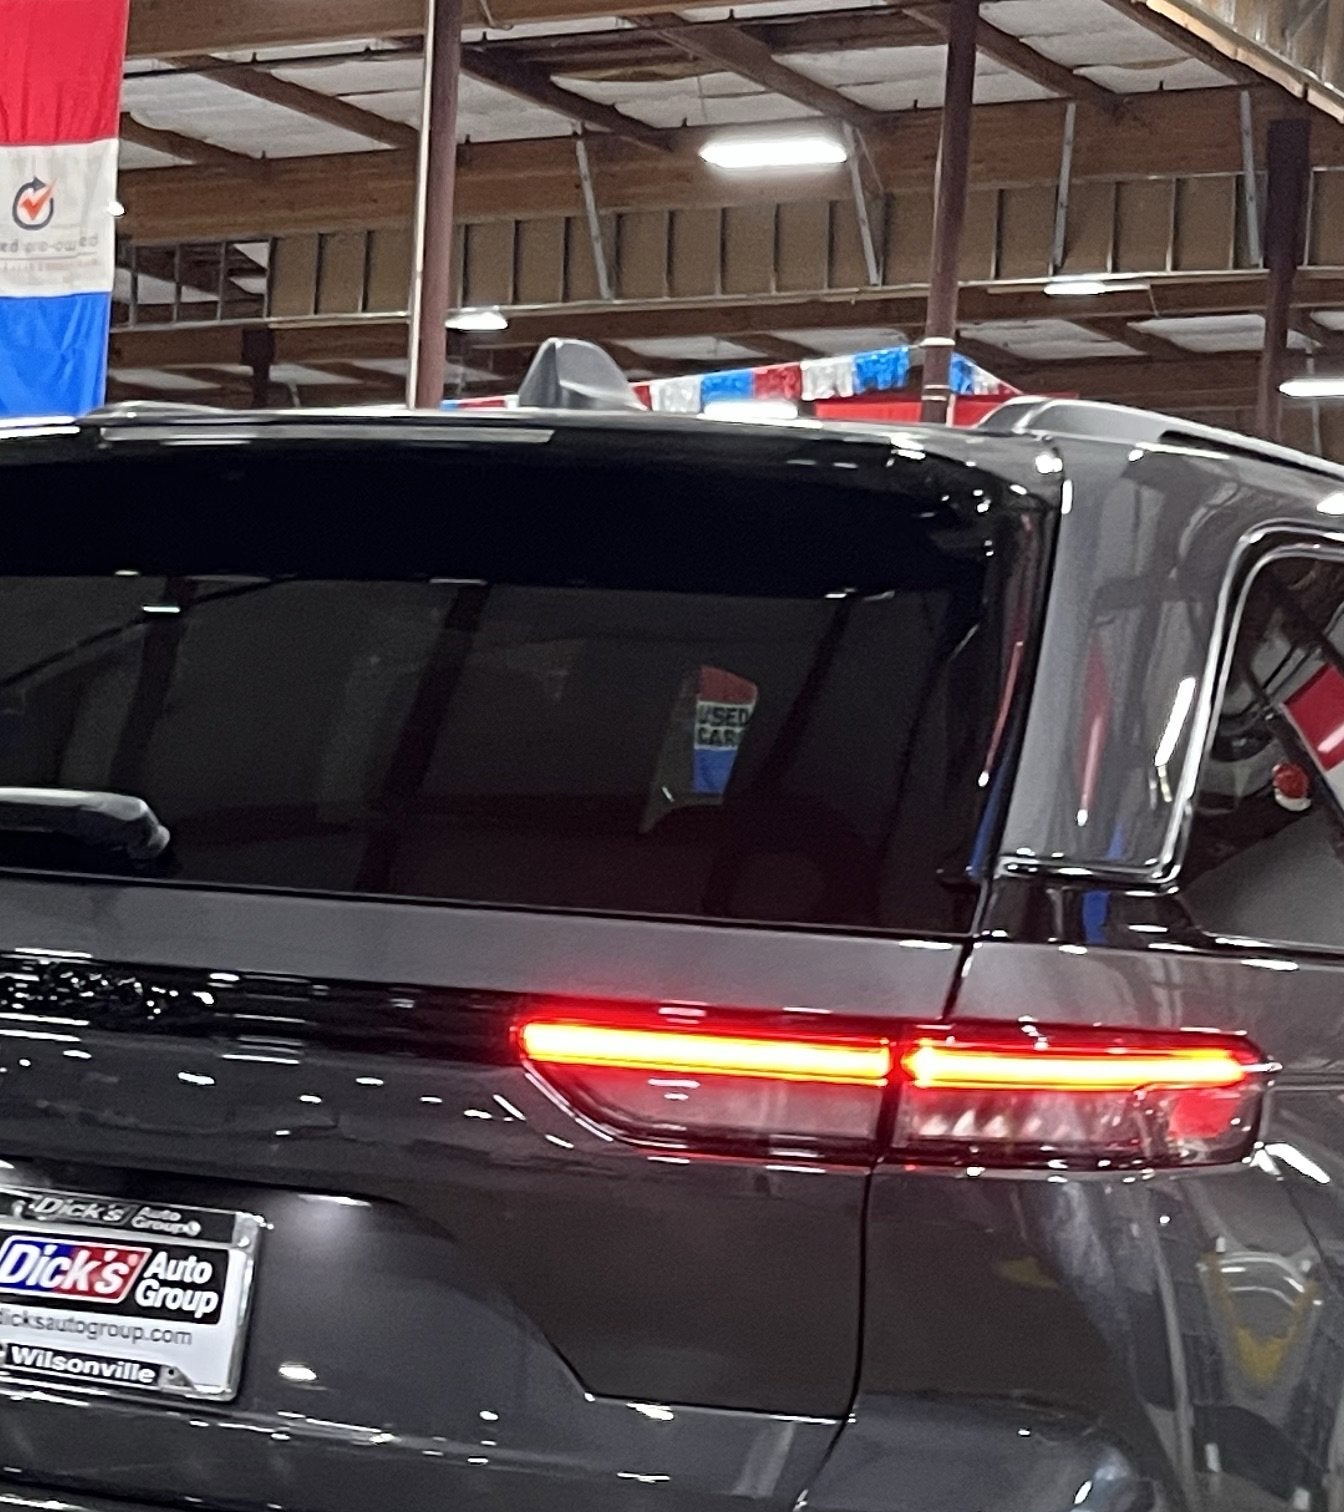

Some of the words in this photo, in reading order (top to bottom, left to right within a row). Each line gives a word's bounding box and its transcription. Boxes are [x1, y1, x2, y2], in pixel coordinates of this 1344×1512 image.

[698, 705, 750, 727] USED
[137, 1206, 182, 1222] Auto
[144, 1251, 214, 1285] Auto
[134, 1278, 220, 1319] Group
[10, 1345, 157, 1384] Wilsonville
